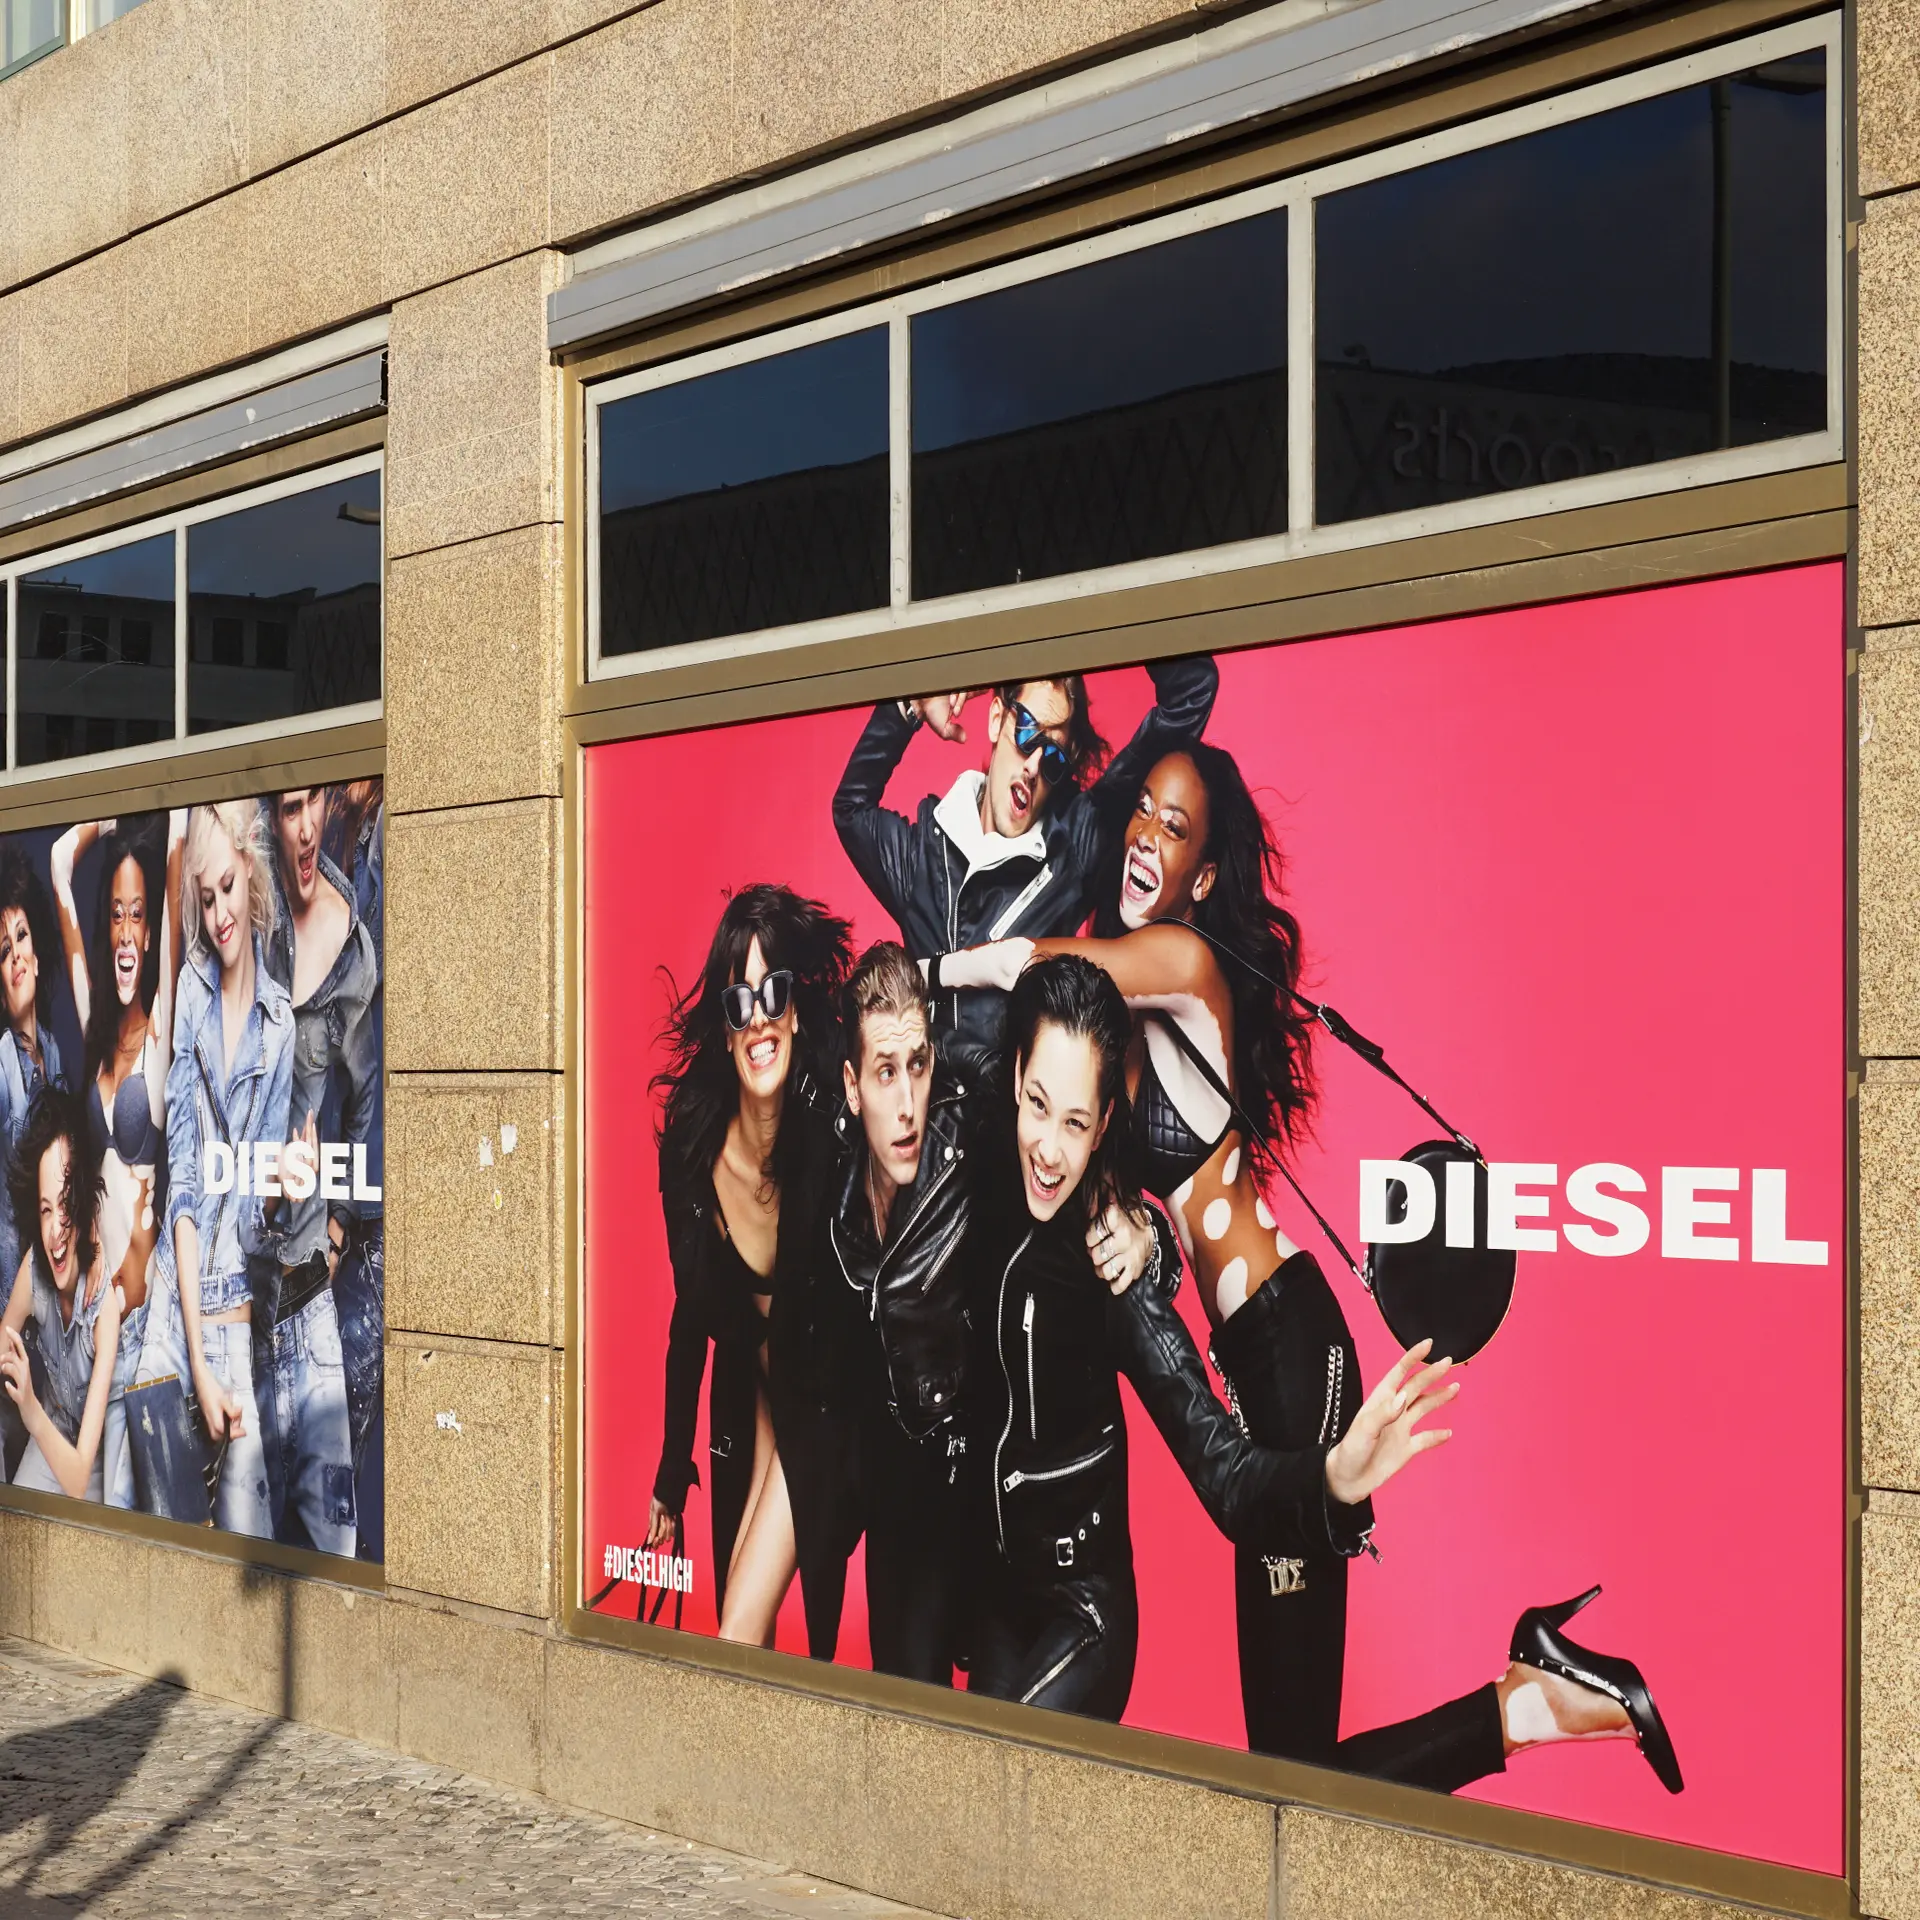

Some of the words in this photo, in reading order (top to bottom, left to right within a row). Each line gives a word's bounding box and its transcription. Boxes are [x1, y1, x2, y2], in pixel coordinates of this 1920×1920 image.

[203, 1140, 382, 1202] DIESEL
[1359, 1159, 1829, 1266] DIESEL
[603, 1544, 693, 1594] #DIESELHIGH
